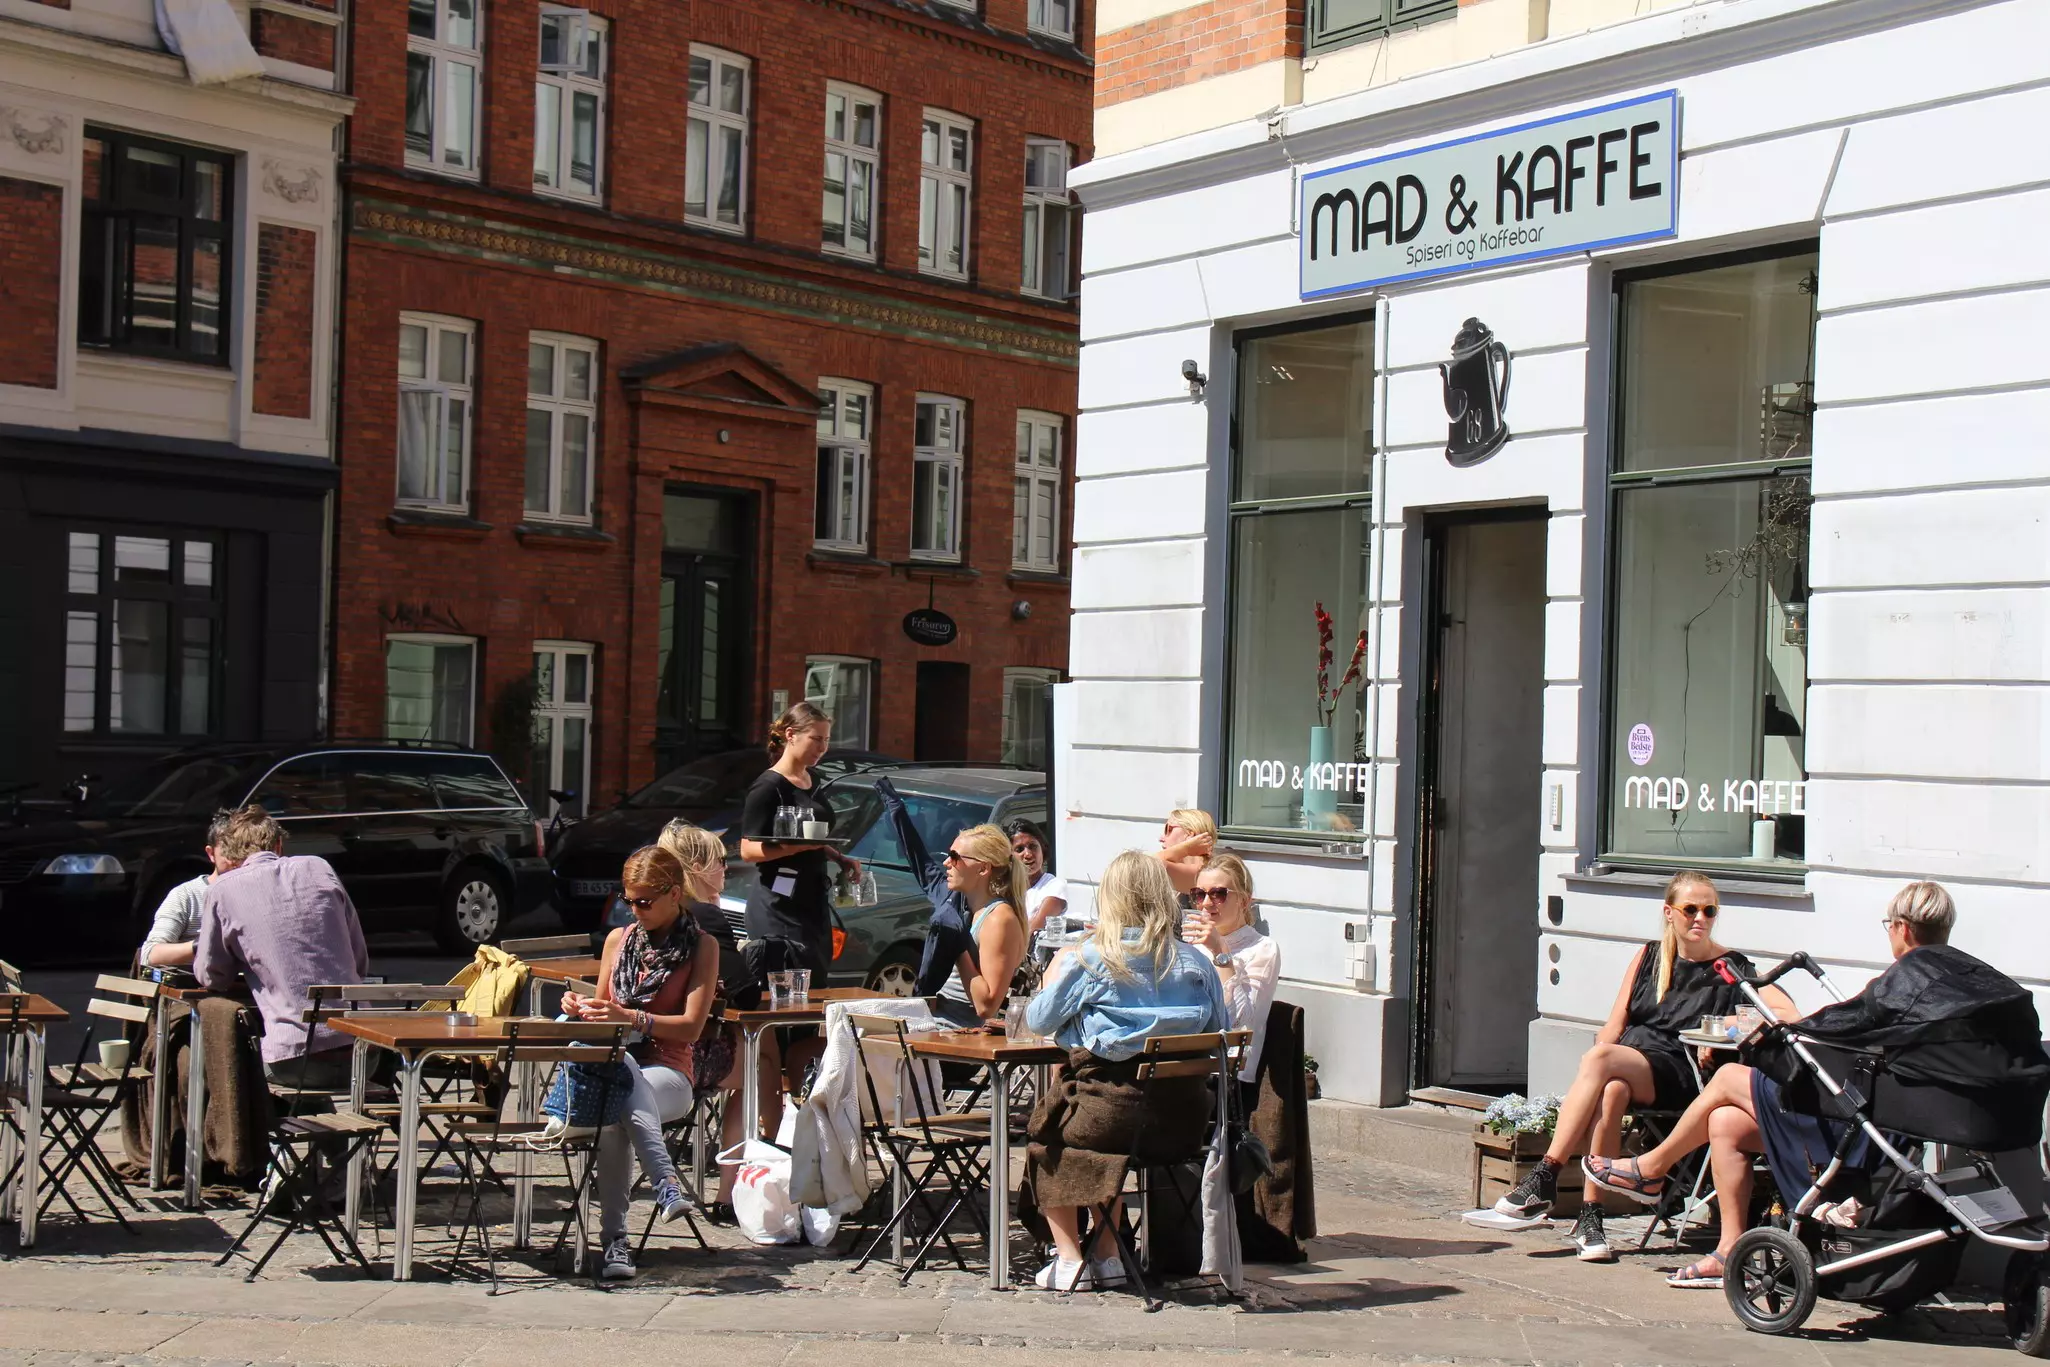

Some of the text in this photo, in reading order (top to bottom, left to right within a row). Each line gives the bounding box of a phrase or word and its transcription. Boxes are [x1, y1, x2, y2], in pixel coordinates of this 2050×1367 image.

[1310, 120, 1662, 261] MAD & KAFFE
[1406, 226, 1545, 267] Spiseri og Kaffebar
[1466, 408, 1482, 443] 68
[1238, 759, 1366, 793] MAD & KAFFE
[1624, 775, 1806, 816] MAD & KAFFE
